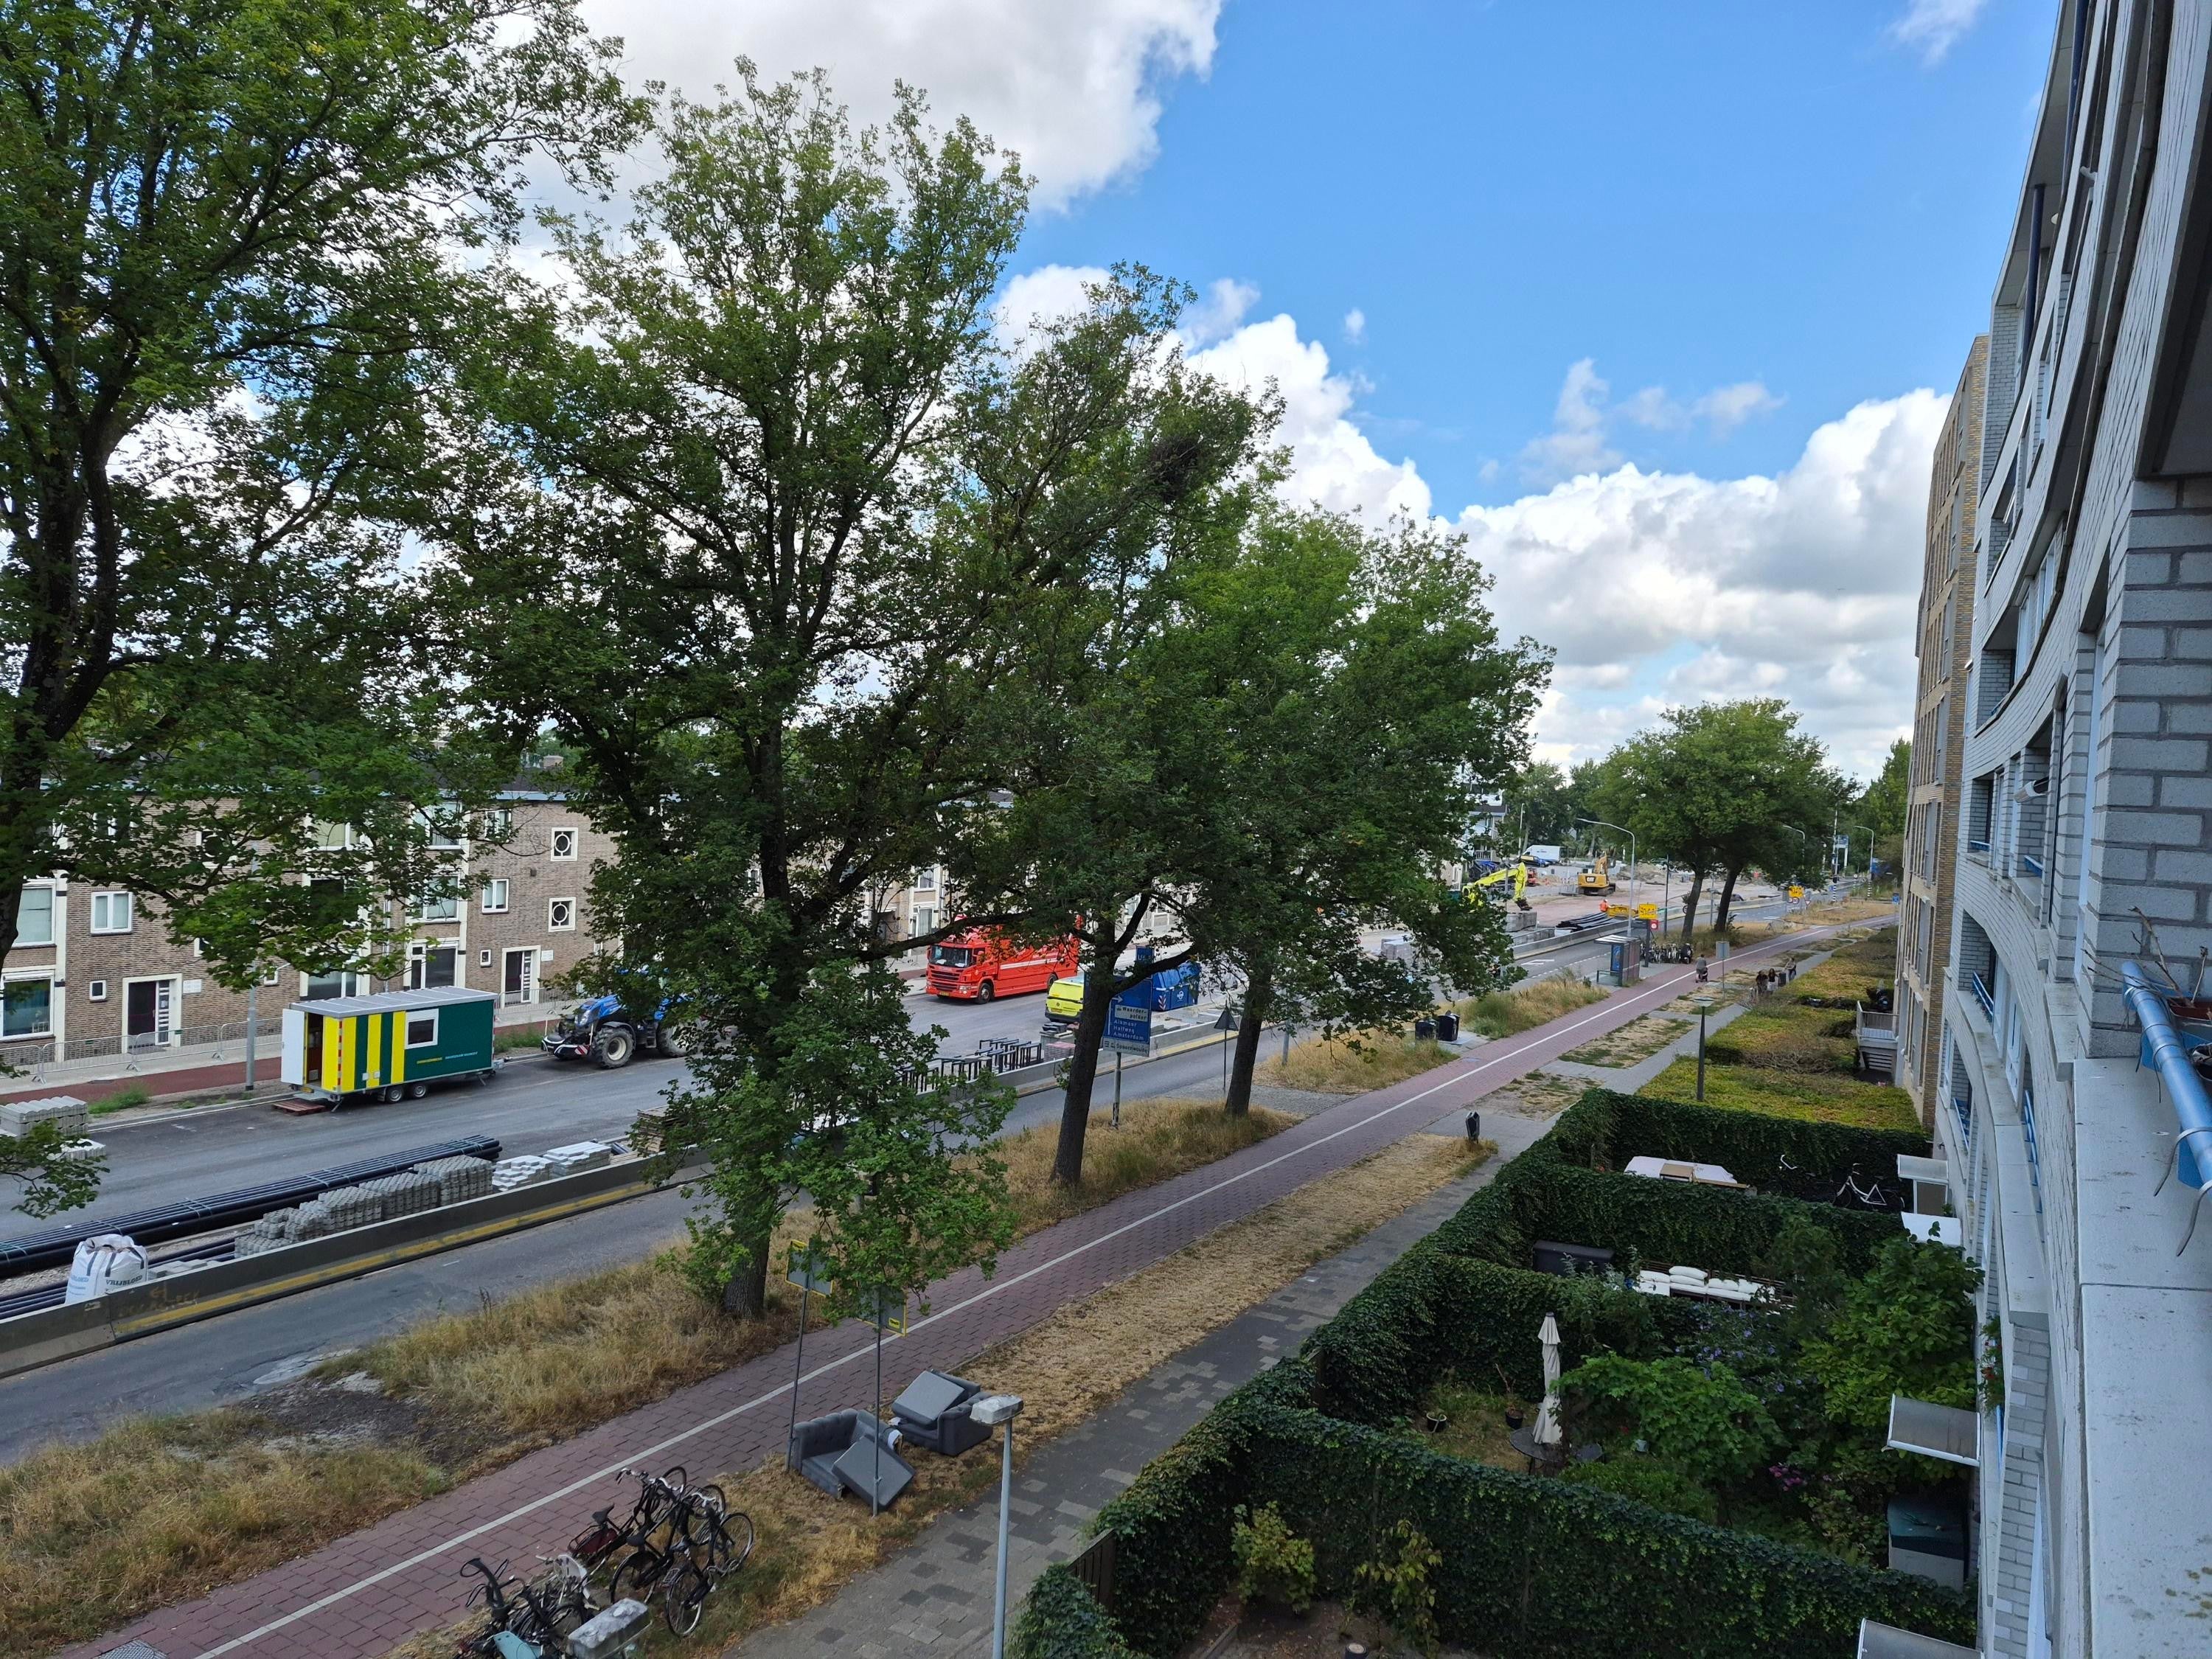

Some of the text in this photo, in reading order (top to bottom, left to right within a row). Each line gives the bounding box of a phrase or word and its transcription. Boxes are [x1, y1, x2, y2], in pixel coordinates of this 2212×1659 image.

[1113, 1019, 1137, 1027] Alkmaar
[1113, 1026, 1135, 1034] Halfweg
[1113, 1032, 1144, 1040] Amsterdam
[105, 1275, 142, 1286] VRIJBLOED
